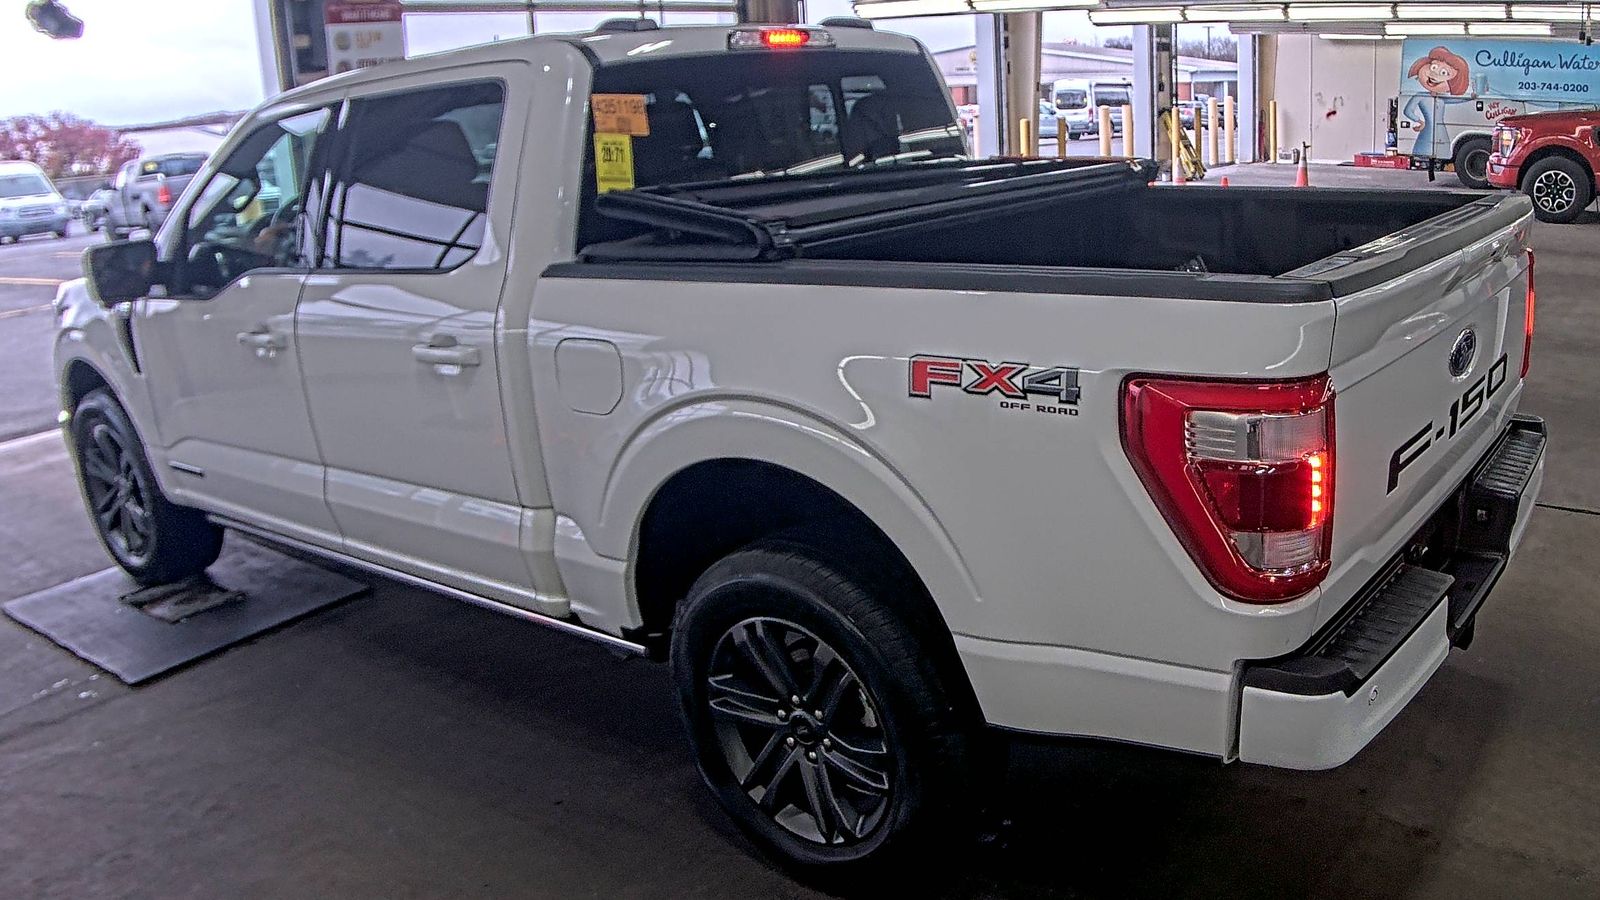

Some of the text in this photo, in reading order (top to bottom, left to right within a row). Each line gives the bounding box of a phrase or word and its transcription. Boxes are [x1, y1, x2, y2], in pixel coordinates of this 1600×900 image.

[1475, 50, 1556, 75] Culligan
[1518, 82, 1589, 92] 203-744-0200
[909, 354, 1081, 405] FX4
[1000, 401, 1079, 417] OFF ROAD
[1386, 352, 1508, 496] F-150
